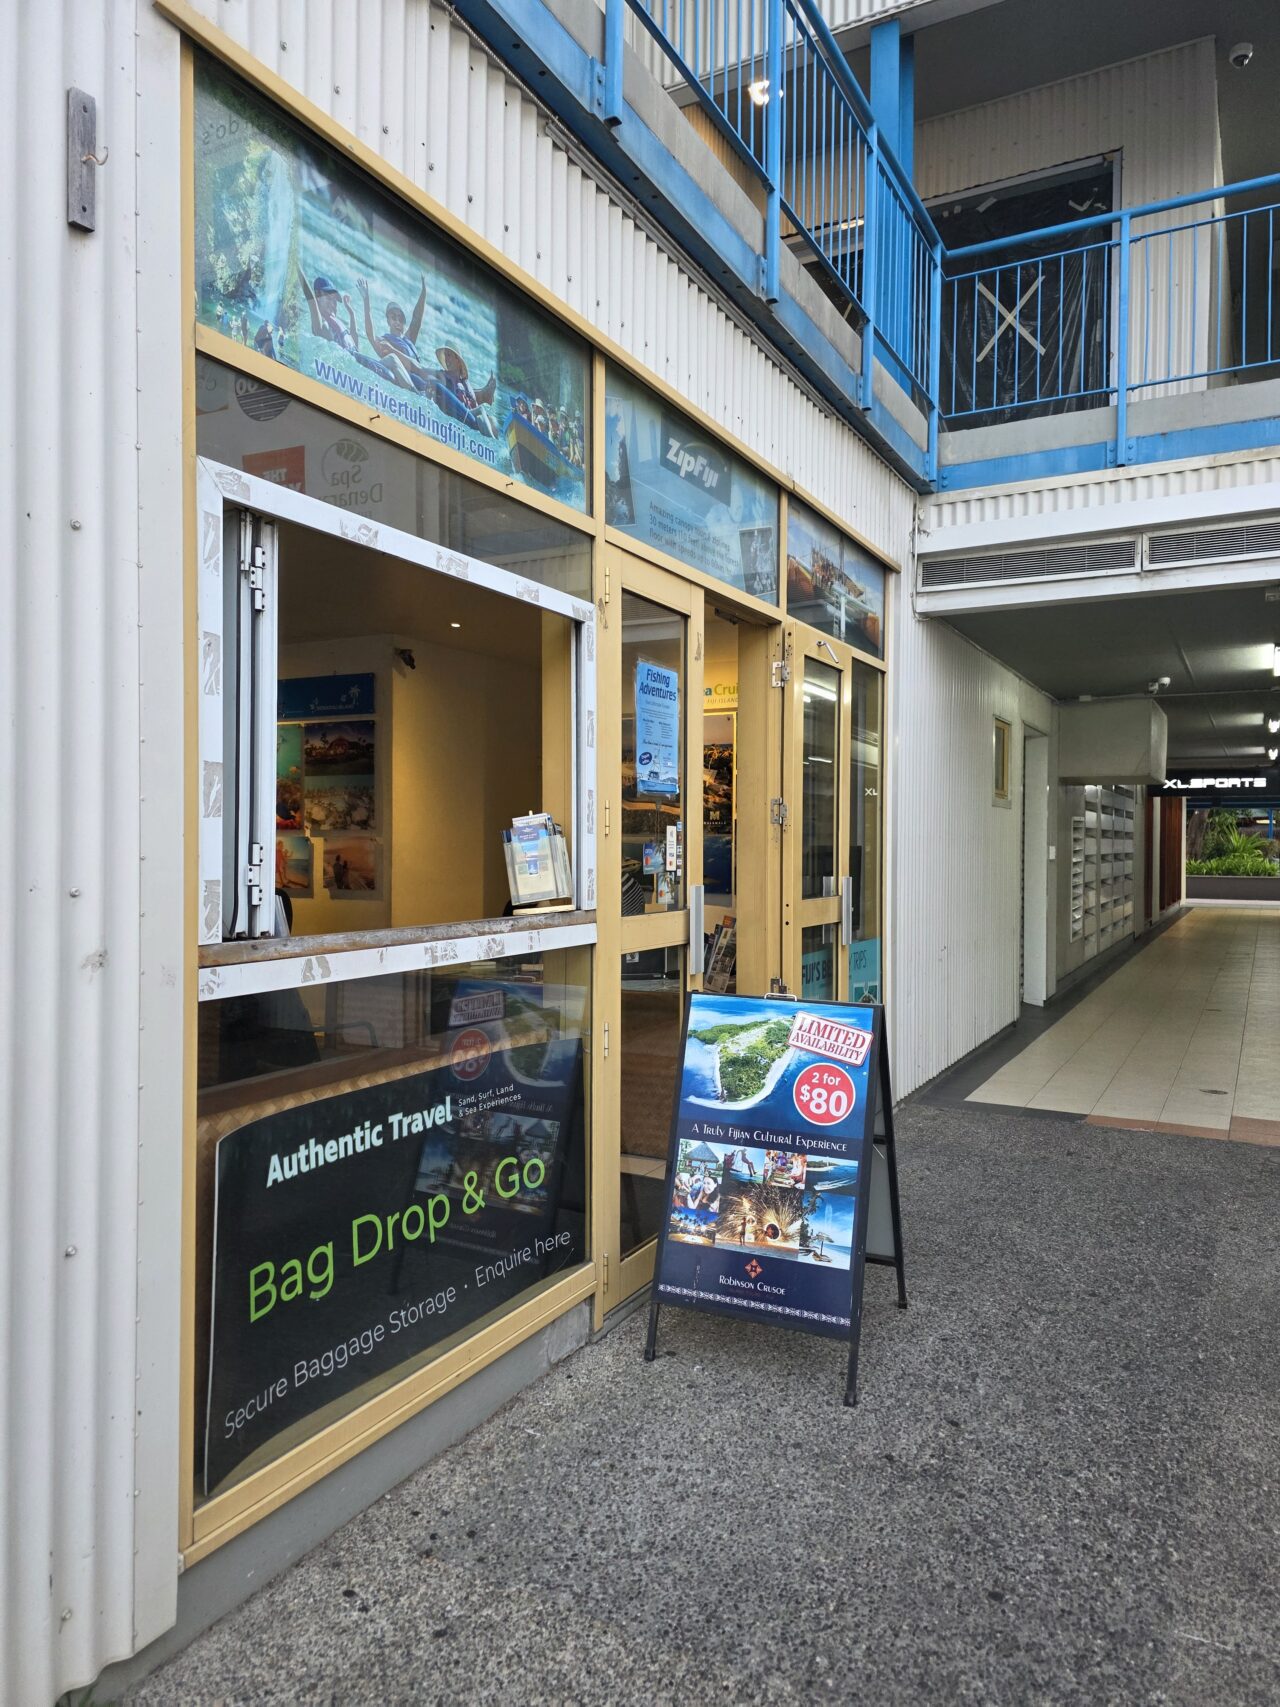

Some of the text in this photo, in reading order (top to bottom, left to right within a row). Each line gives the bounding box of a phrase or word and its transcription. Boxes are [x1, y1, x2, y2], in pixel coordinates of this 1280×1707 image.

[314, 358, 496, 464] www.rivertubingfiji.com
[639, 681, 677, 702] Adventures
[646, 668, 670, 688] Fishing
[792, 1031, 863, 1063] AVAILABILITY
[796, 1016, 867, 1049] LIMITED
[812, 1072, 841, 1086] 2 for
[458, 1083, 514, 1107] Sand, Surf, Land
[458, 1109, 464, 1118] &
[465, 1105, 477, 1116] Sea
[479, 1092, 522, 1111] Experiences
[800, 1084, 848, 1118] $80
[266, 1096, 453, 1189] Authentic Travel
[691, 1123, 699, 1134] A
[703, 1124, 725, 1137] Truly
[753, 1130, 792, 1146] Cultural
[796, 1135, 848, 1152] Experience
[250, 1156, 546, 1324] Bag Drop & Go
[718, 1275, 755, 1290] Robinson
[757, 1281, 786, 1296] Crusoe
[224, 1229, 572, 1440] Secure Baggage Storage Enquire here
